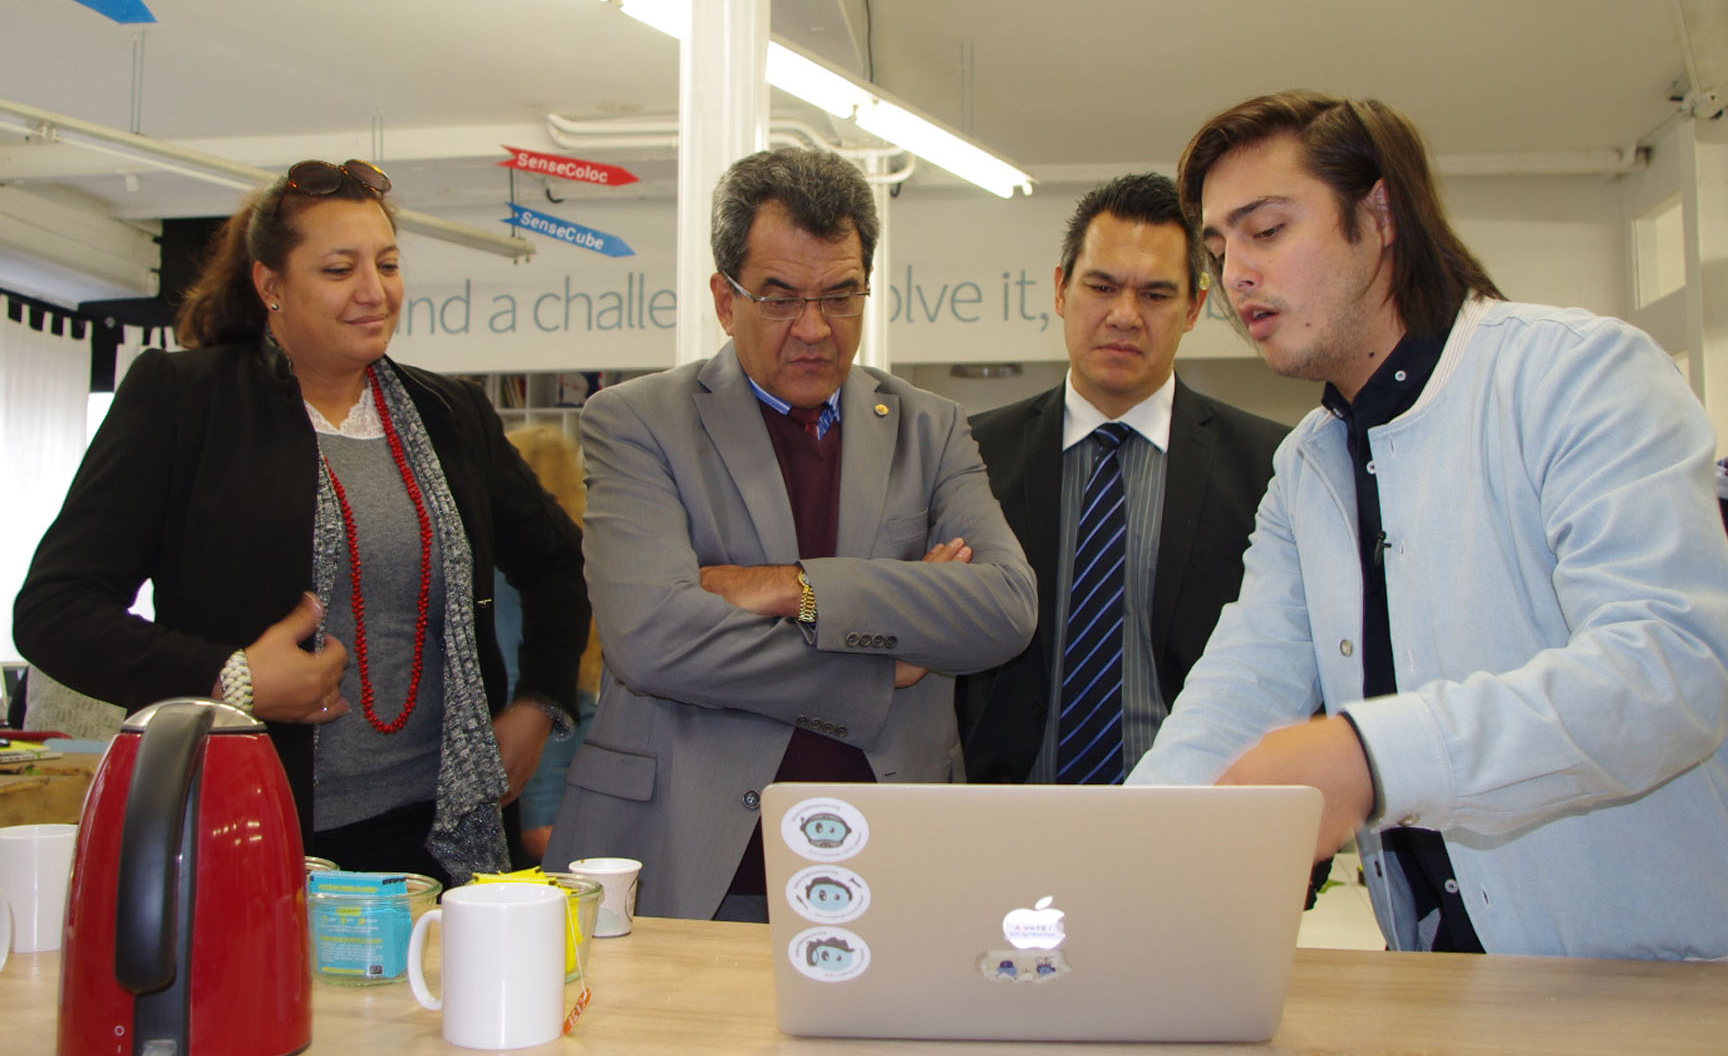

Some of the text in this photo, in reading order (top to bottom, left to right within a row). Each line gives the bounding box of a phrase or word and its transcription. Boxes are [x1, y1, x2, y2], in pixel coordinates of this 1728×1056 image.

[517, 152, 609, 183] SenseColoc
[520, 211, 604, 250] SenseCube
[488, 294, 517, 334] a
[1002, 268, 1050, 333] it,
